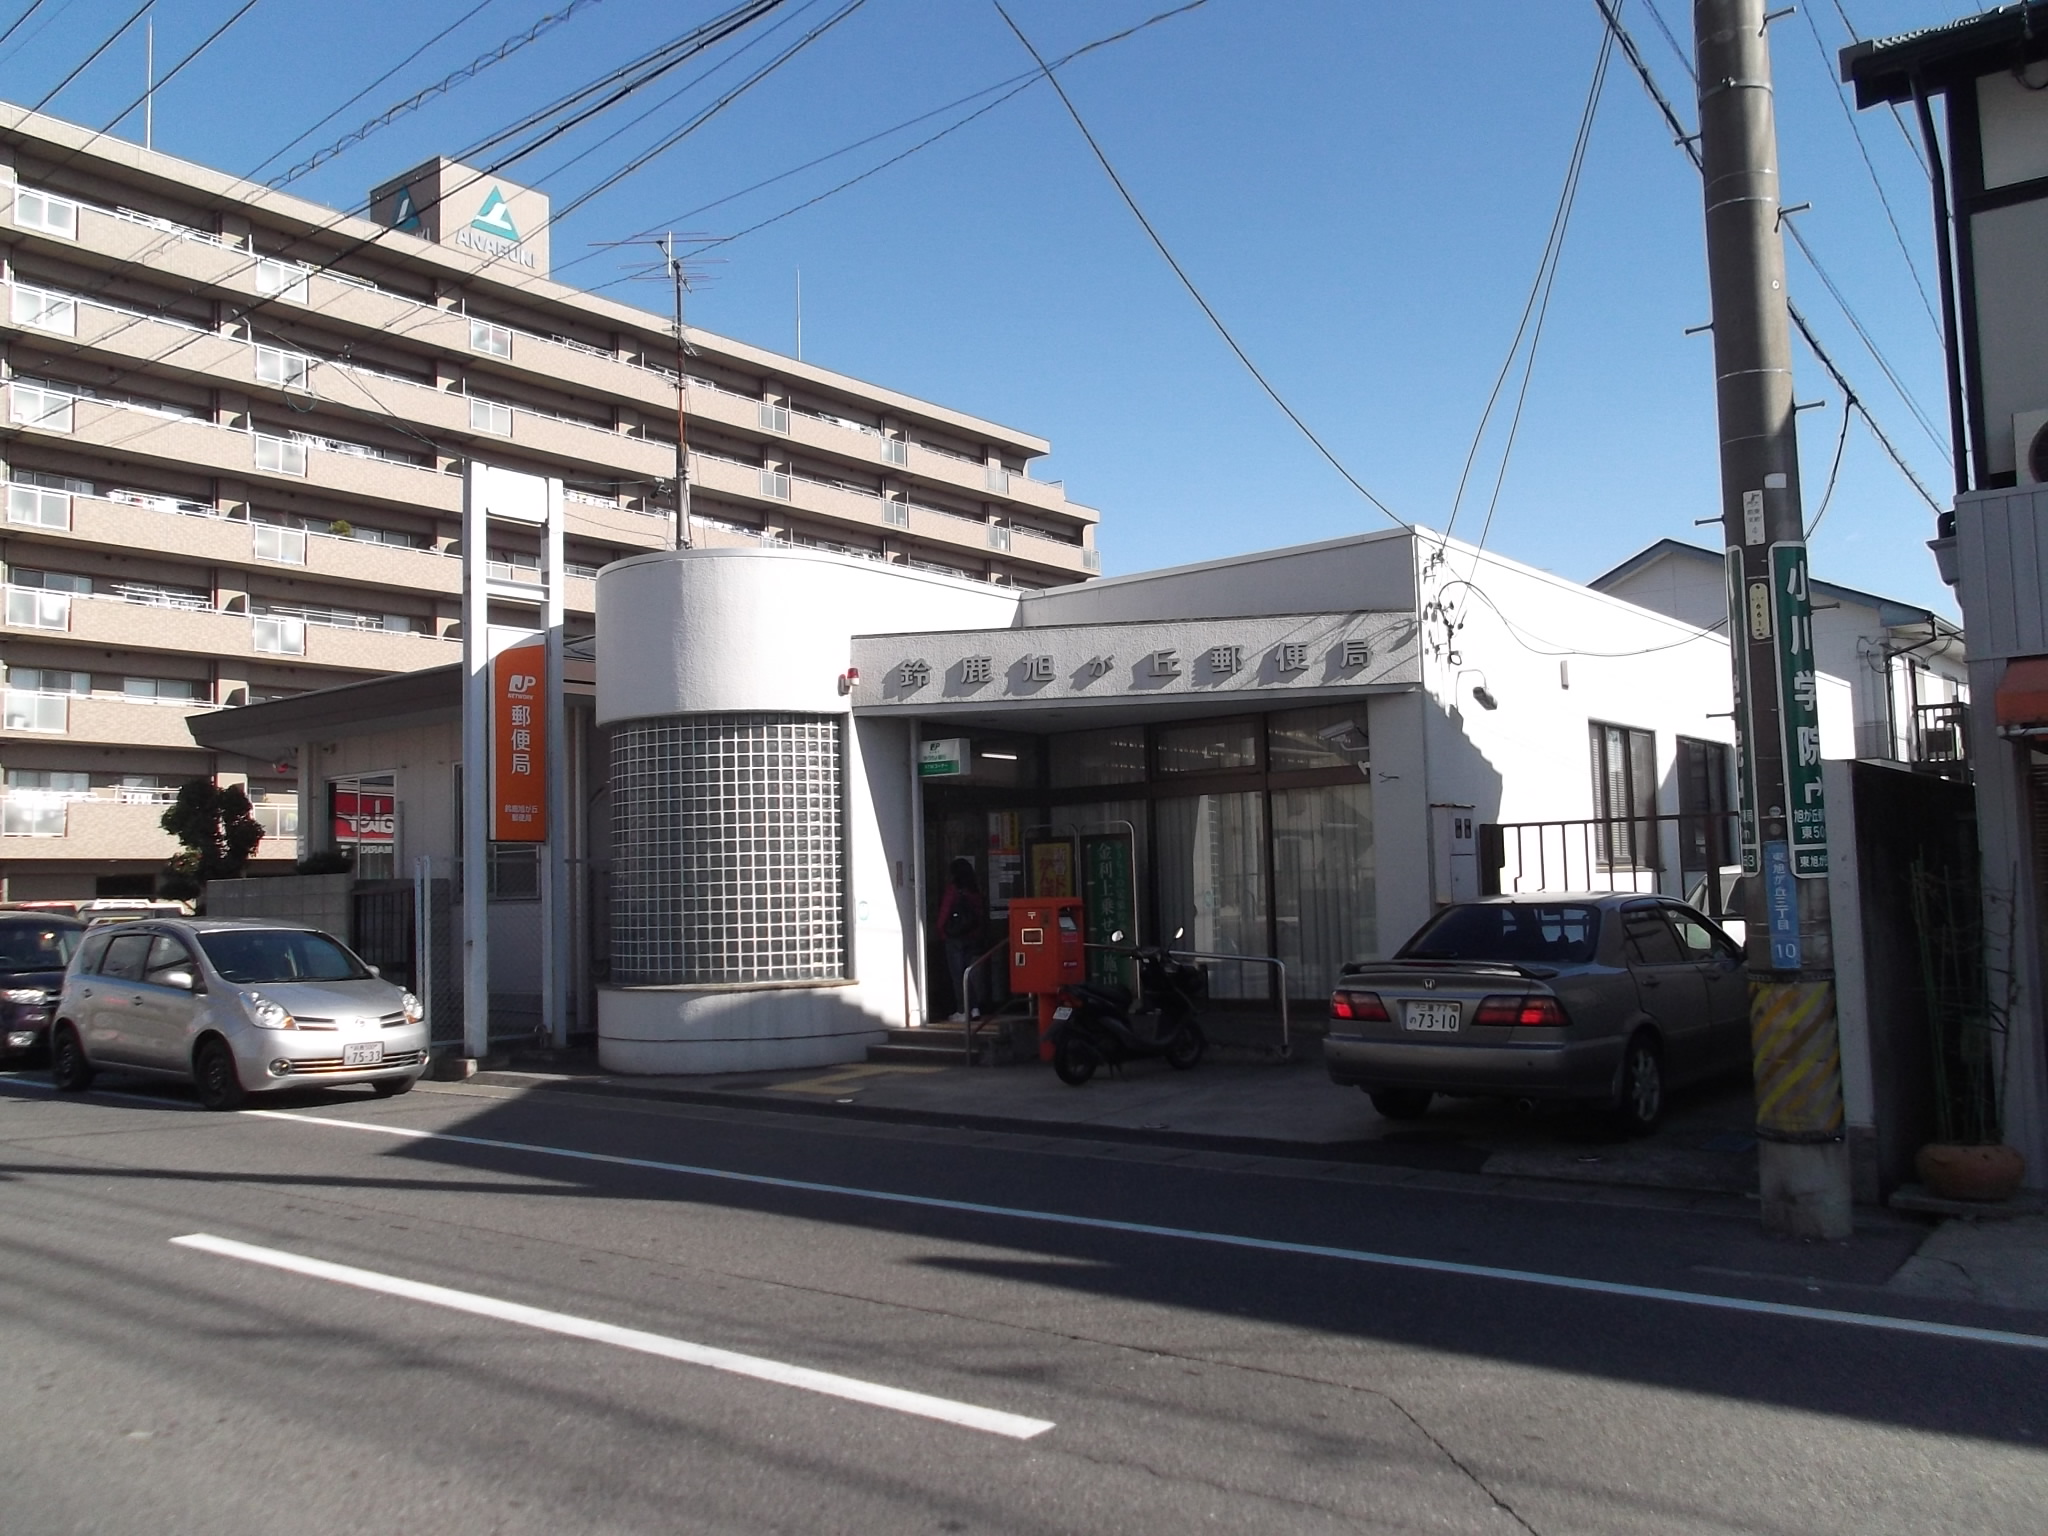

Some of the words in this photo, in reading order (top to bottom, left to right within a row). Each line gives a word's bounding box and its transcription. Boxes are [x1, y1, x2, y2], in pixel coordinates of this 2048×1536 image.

[900, 639, 1374, 689] 鈴鹿旭が丘郵便局
[1786, 560, 1821, 768] 小川学院
[508, 674, 537, 693] JP
[511, 705, 531, 776] 郵便局
[1775, 943, 1797, 960] 10
[1418, 1013, 1457, 1029] 73-10
[352, 1050, 381, 1063] 75-33
